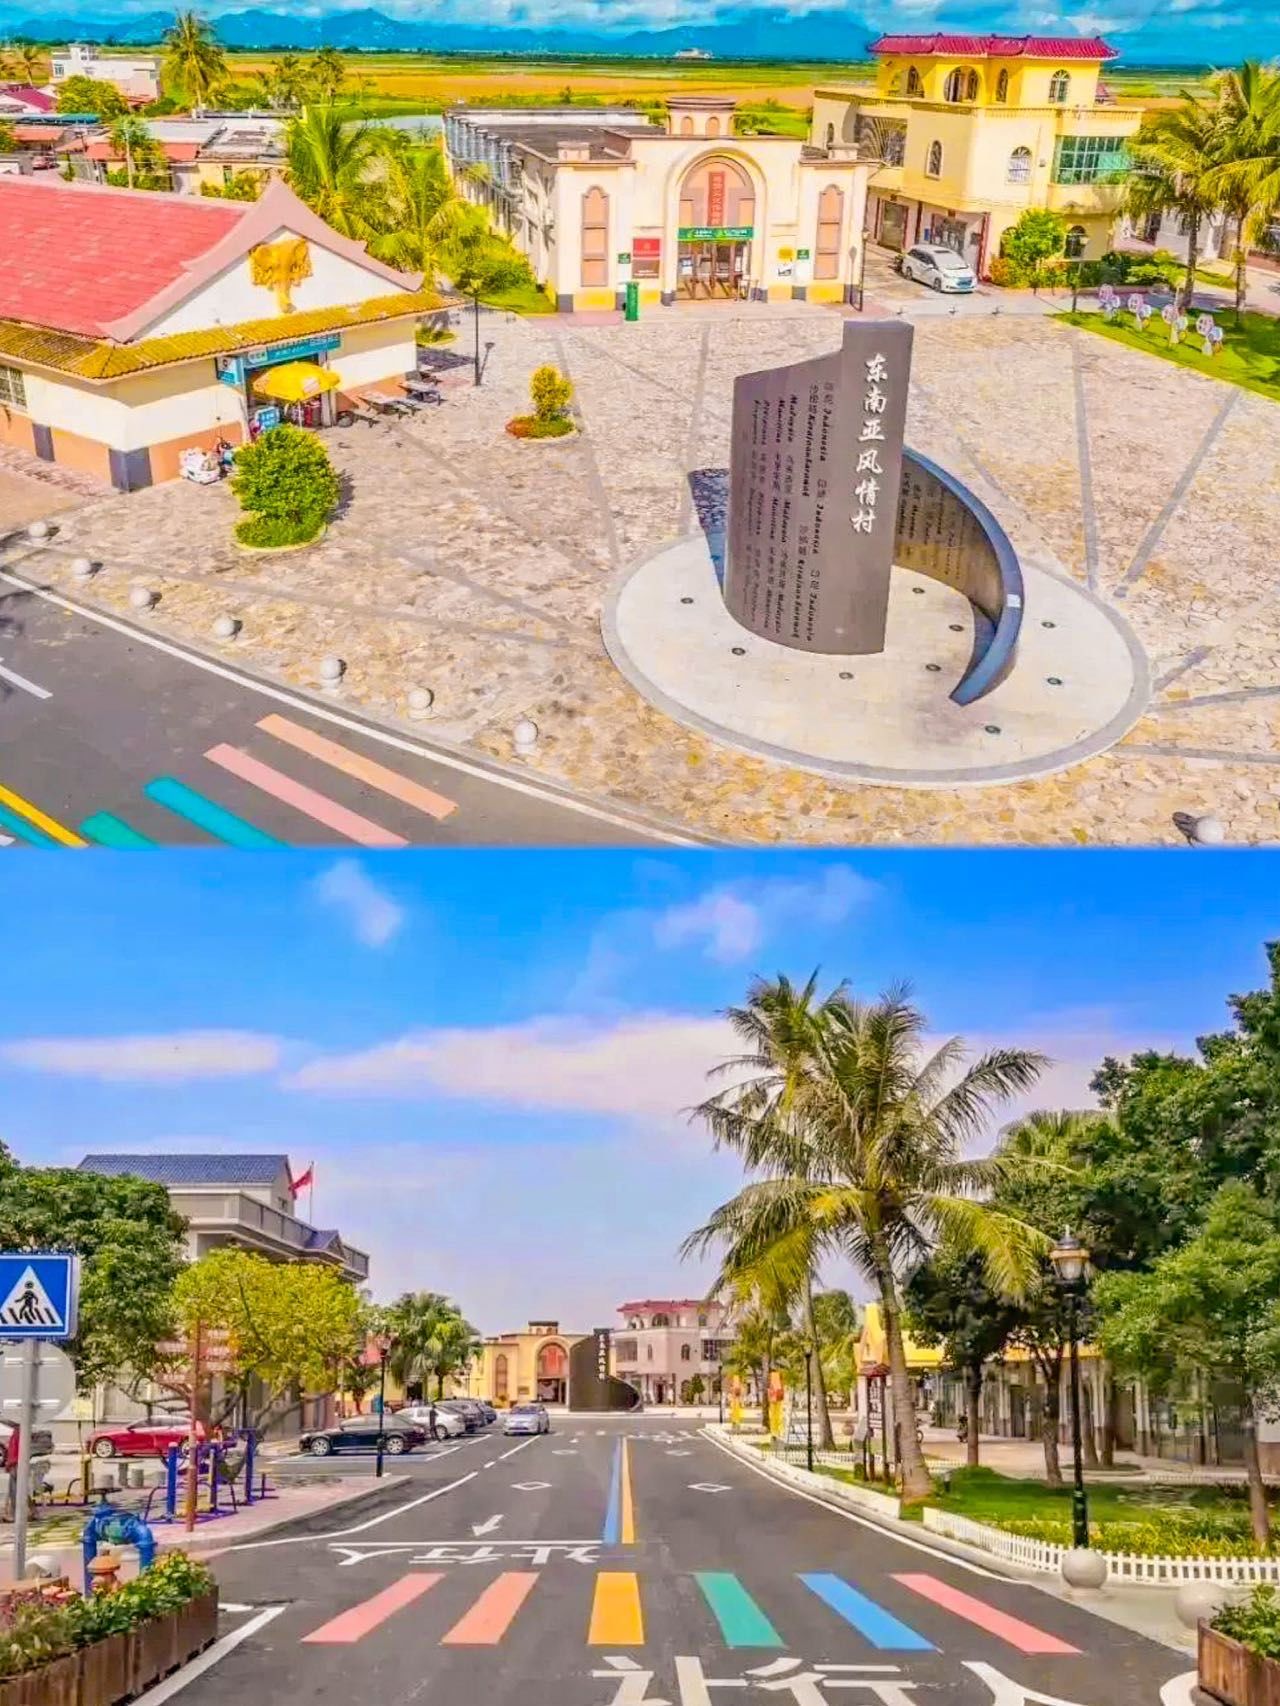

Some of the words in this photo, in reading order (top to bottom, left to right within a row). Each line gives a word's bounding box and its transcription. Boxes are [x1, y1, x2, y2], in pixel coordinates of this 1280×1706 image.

[850, 352, 889, 534] 东南亚风情村
[330, 1546, 601, 1566] 让行人
